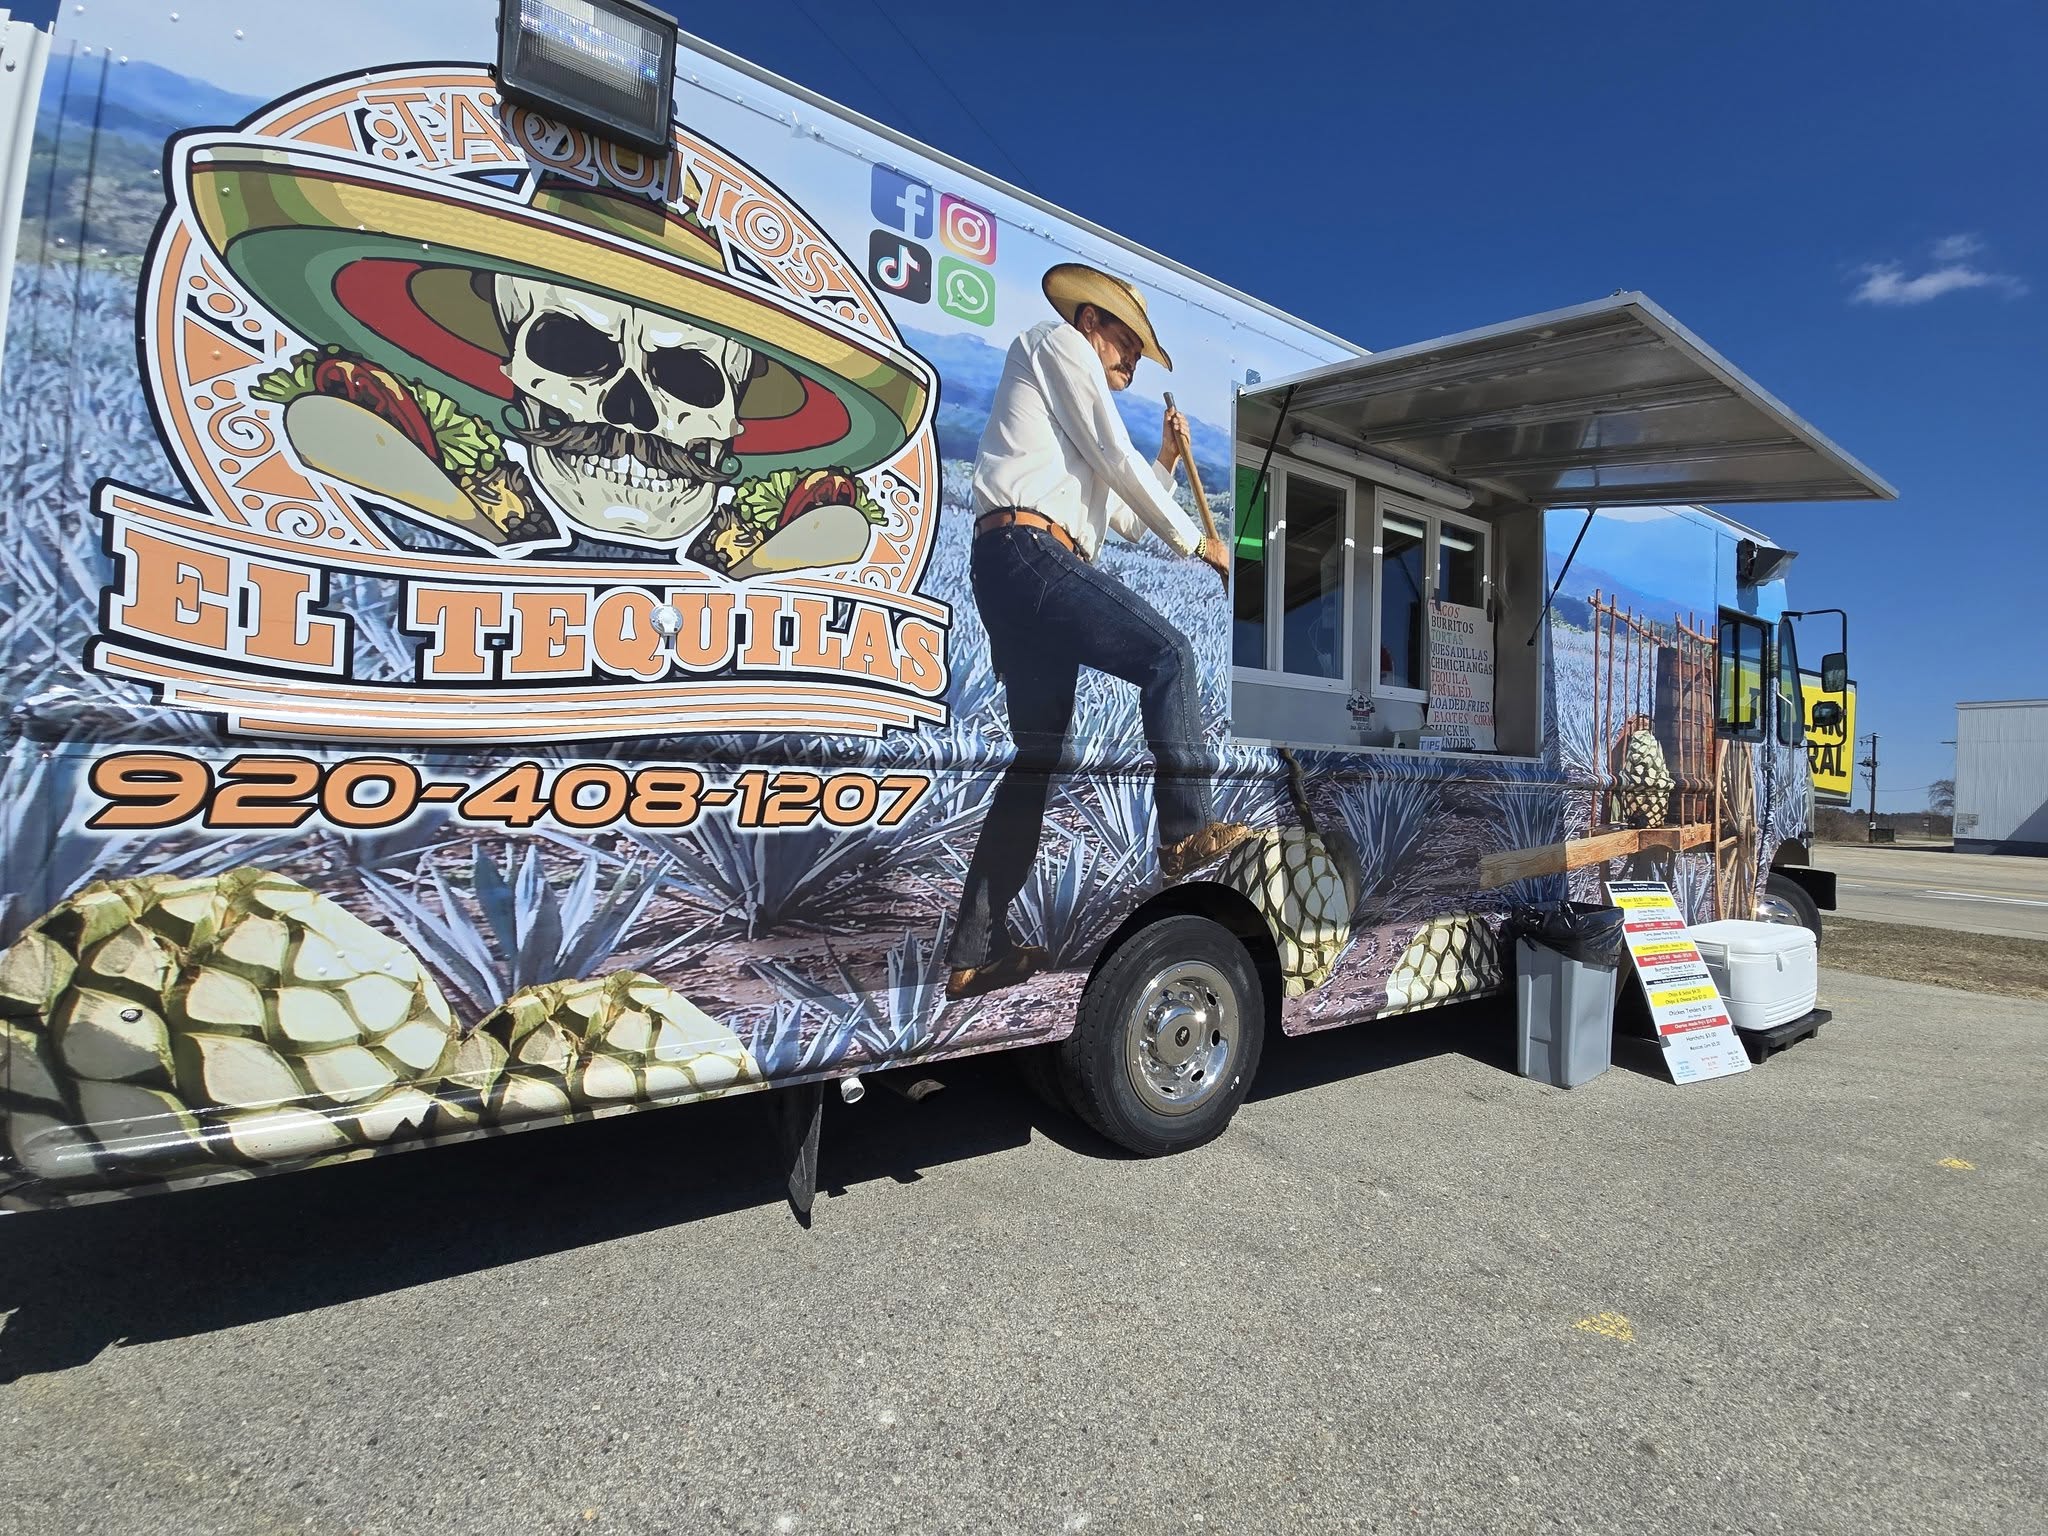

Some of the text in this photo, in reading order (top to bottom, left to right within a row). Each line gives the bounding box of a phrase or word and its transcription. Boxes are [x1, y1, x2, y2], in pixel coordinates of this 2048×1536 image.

[367, 91, 846, 295] TAQUITOS
[122, 526, 946, 696] EL TEQUILAS
[1431, 616, 1474, 634] BURRITOS
[1431, 629, 1463, 645] TORTAS
[1431, 642, 1488, 661] QUESADILLAS
[1431, 657, 1493, 675] CHIMICHANGAS
[1431, 670, 1468, 685] TEQUILA
[1473, 715, 1494, 726] CORN
[1420, 740, 1440, 750] TIPS
[86, 754, 932, 829] 920-408-1207
